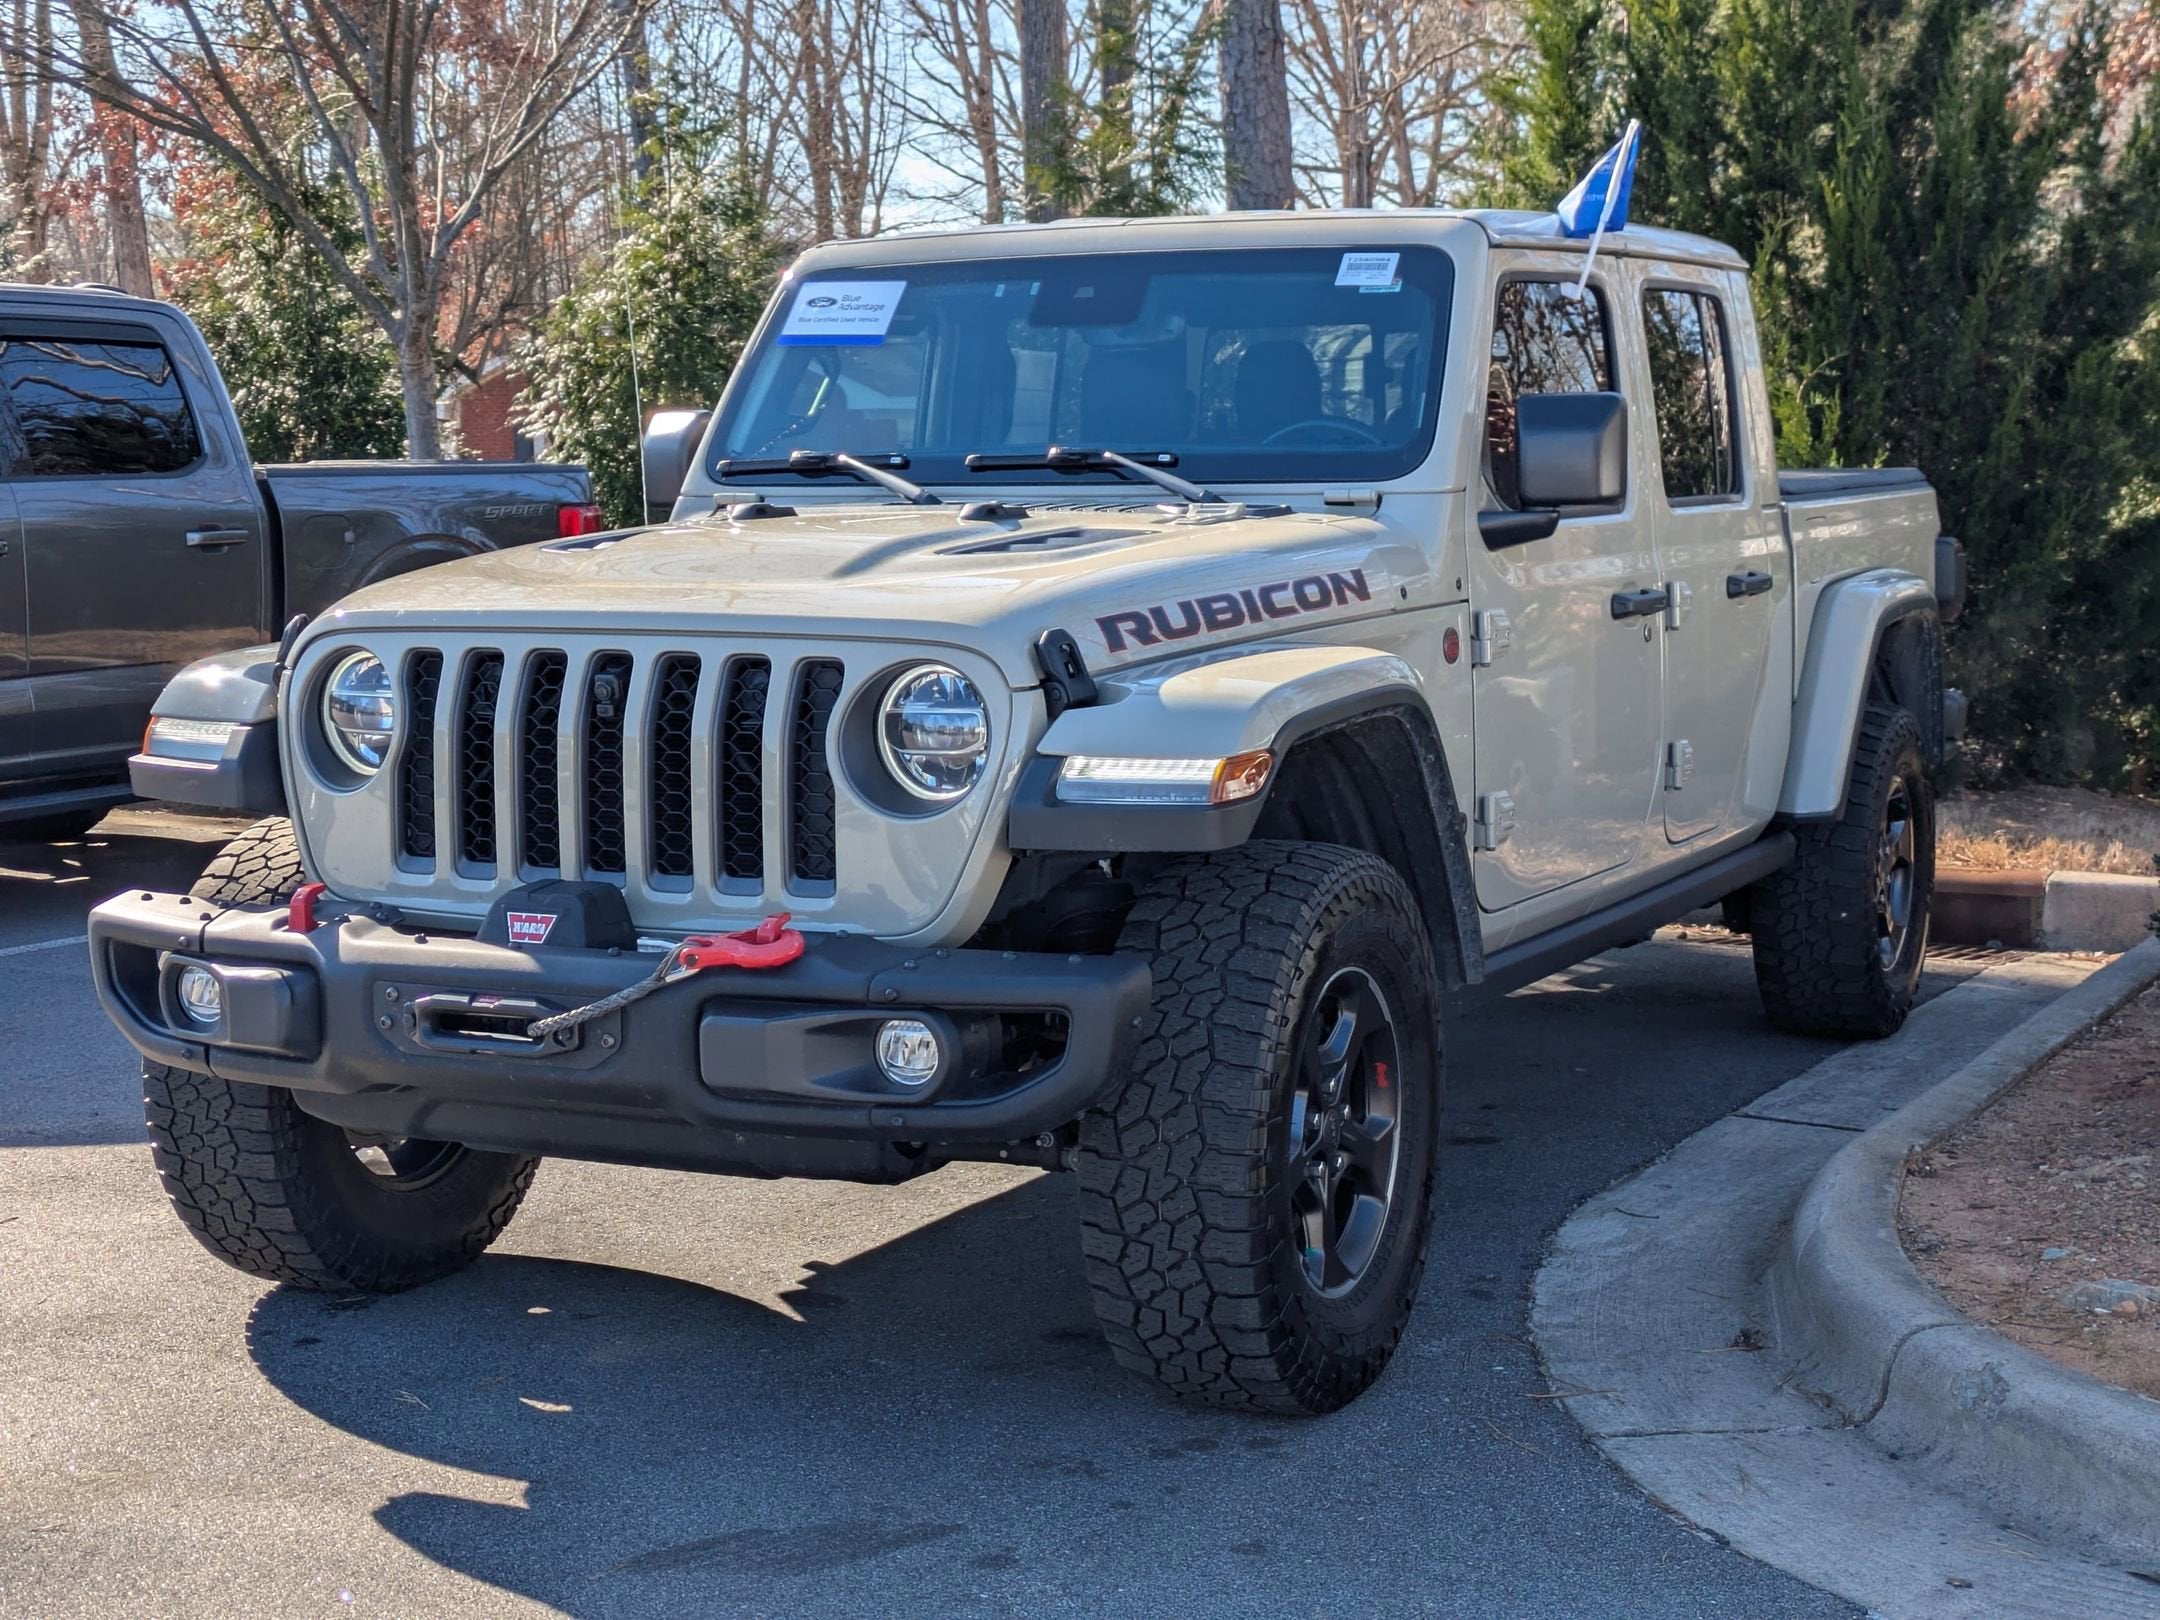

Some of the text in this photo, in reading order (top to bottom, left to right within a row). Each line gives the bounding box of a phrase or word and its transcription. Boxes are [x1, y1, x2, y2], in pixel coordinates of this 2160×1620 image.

[841, 294, 862, 302] Blue
[838, 303, 885, 312] Advantage
[484, 504, 549, 519] SPORT
[1095, 568, 1372, 653] RUBICON
[512, 921, 546, 934] WARN
